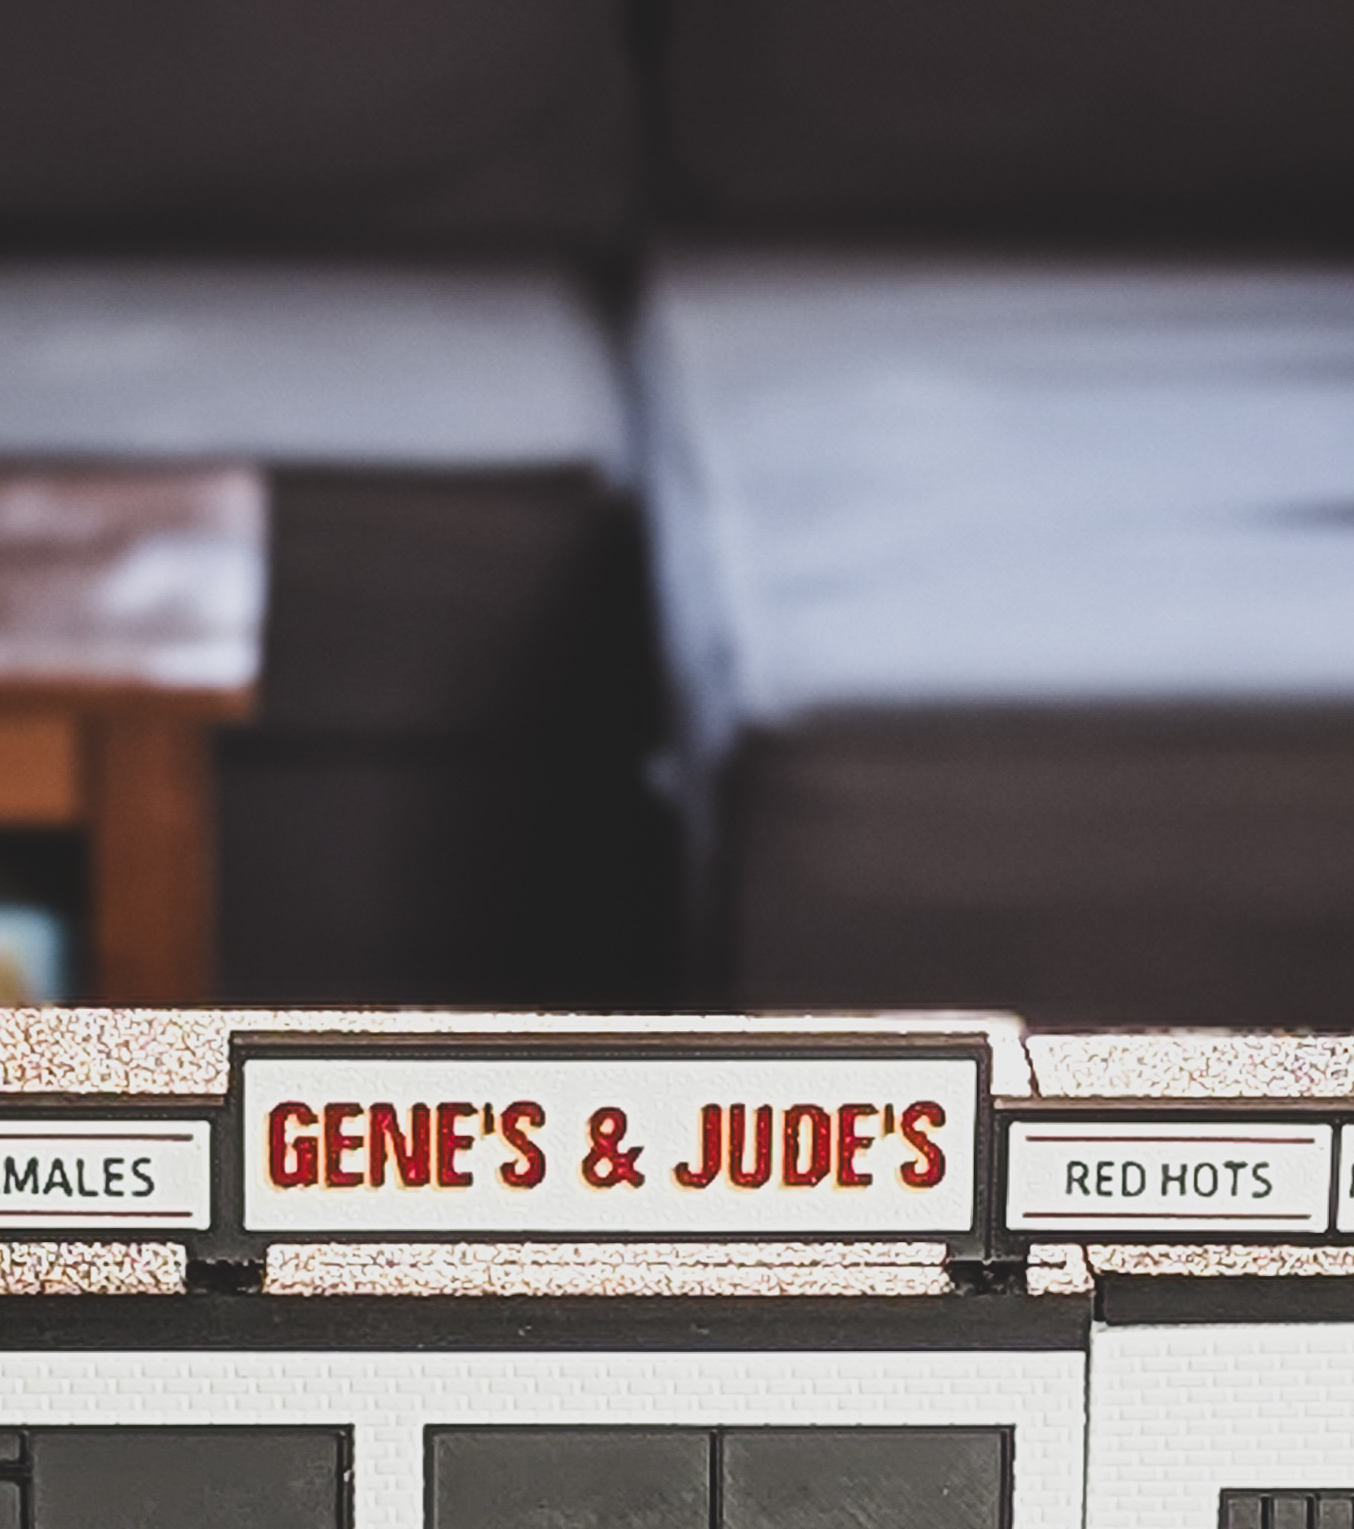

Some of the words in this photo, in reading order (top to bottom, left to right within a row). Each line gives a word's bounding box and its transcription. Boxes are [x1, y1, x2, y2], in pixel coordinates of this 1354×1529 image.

[266, 1100, 547, 1190] GENE'S
[581, 1105, 646, 1190] &
[672, 1100, 948, 1190] JUDE'S
[1065, 1160, 1147, 1198] RED
[1160, 1160, 1274, 1200] HOTS
